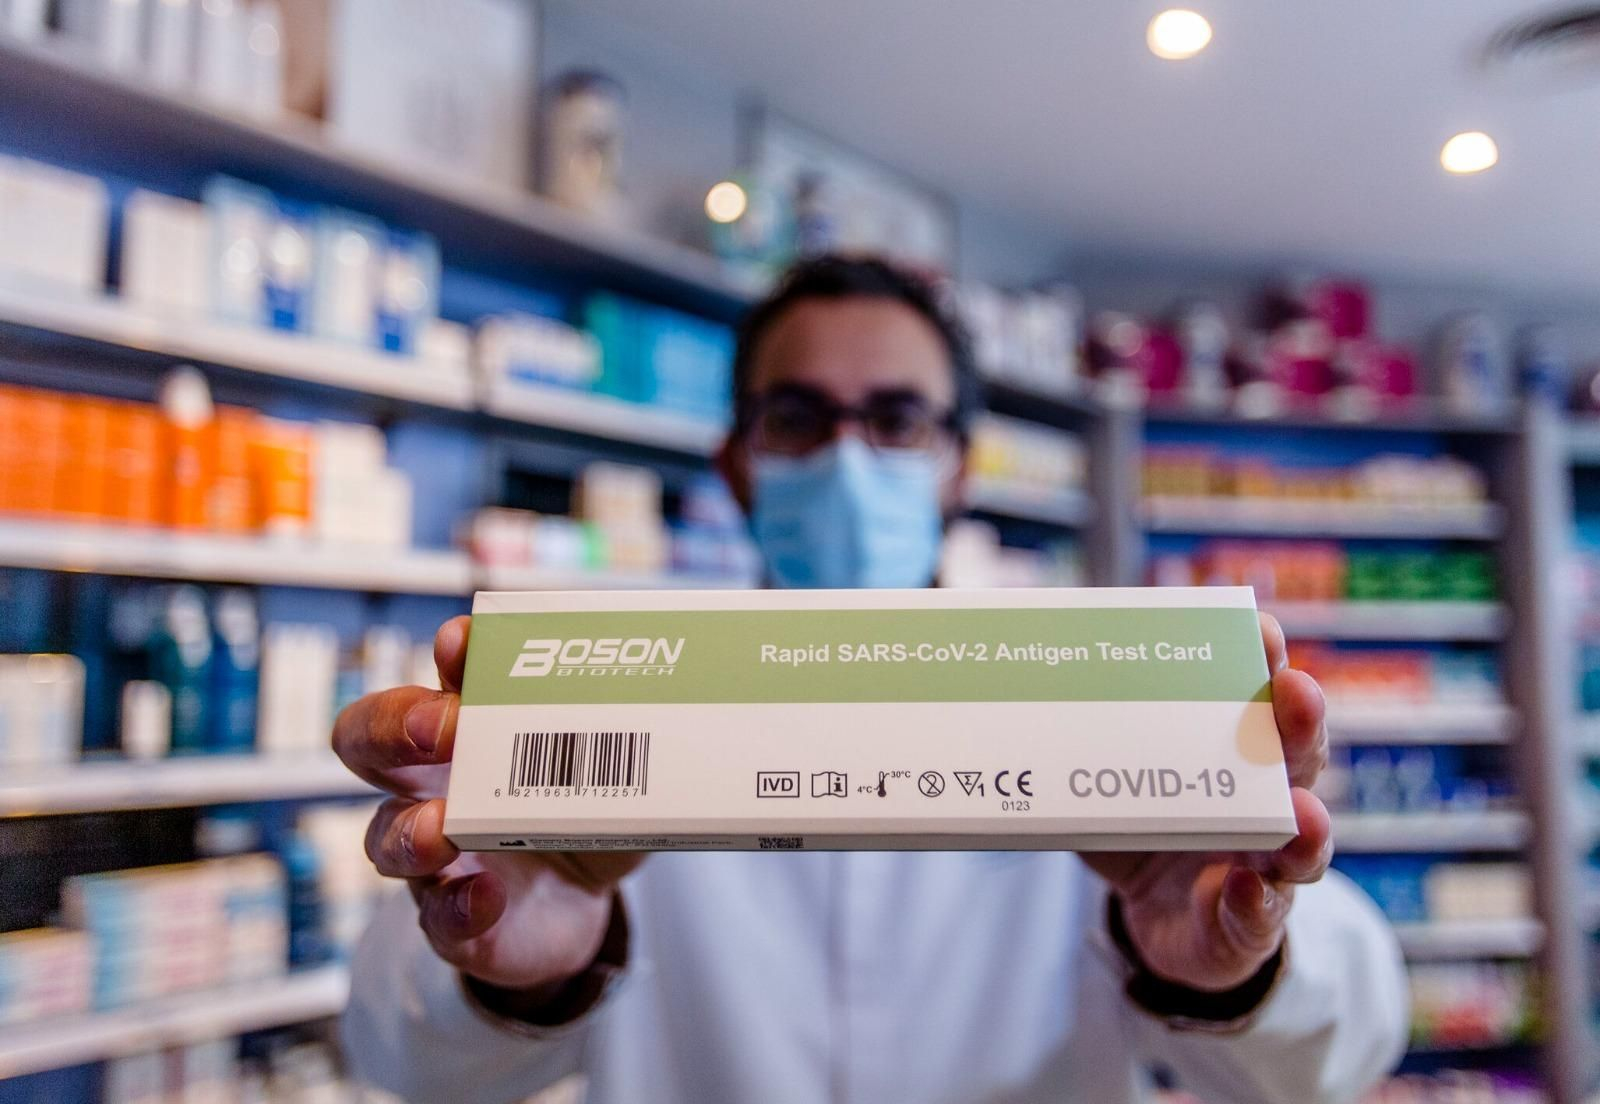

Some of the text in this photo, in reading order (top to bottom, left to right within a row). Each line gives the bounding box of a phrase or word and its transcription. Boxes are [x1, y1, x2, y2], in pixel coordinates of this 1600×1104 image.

[508, 638, 686, 677] BOSON
[760, 642, 1213, 667] Rapid SARS-CoV-2 Antigen Test Card
[556, 667, 675, 677] BIOTECH
[891, 770, 911, 778] 30°C
[763, 777, 794, 792] IVD
[857, 785, 873, 794] 4°C
[994, 770, 1034, 797] CE
[1068, 768, 1236, 798] COVID-19
[494, 788, 639, 797] 6 921963 712257
[1001, 800, 1031, 811] 0123
